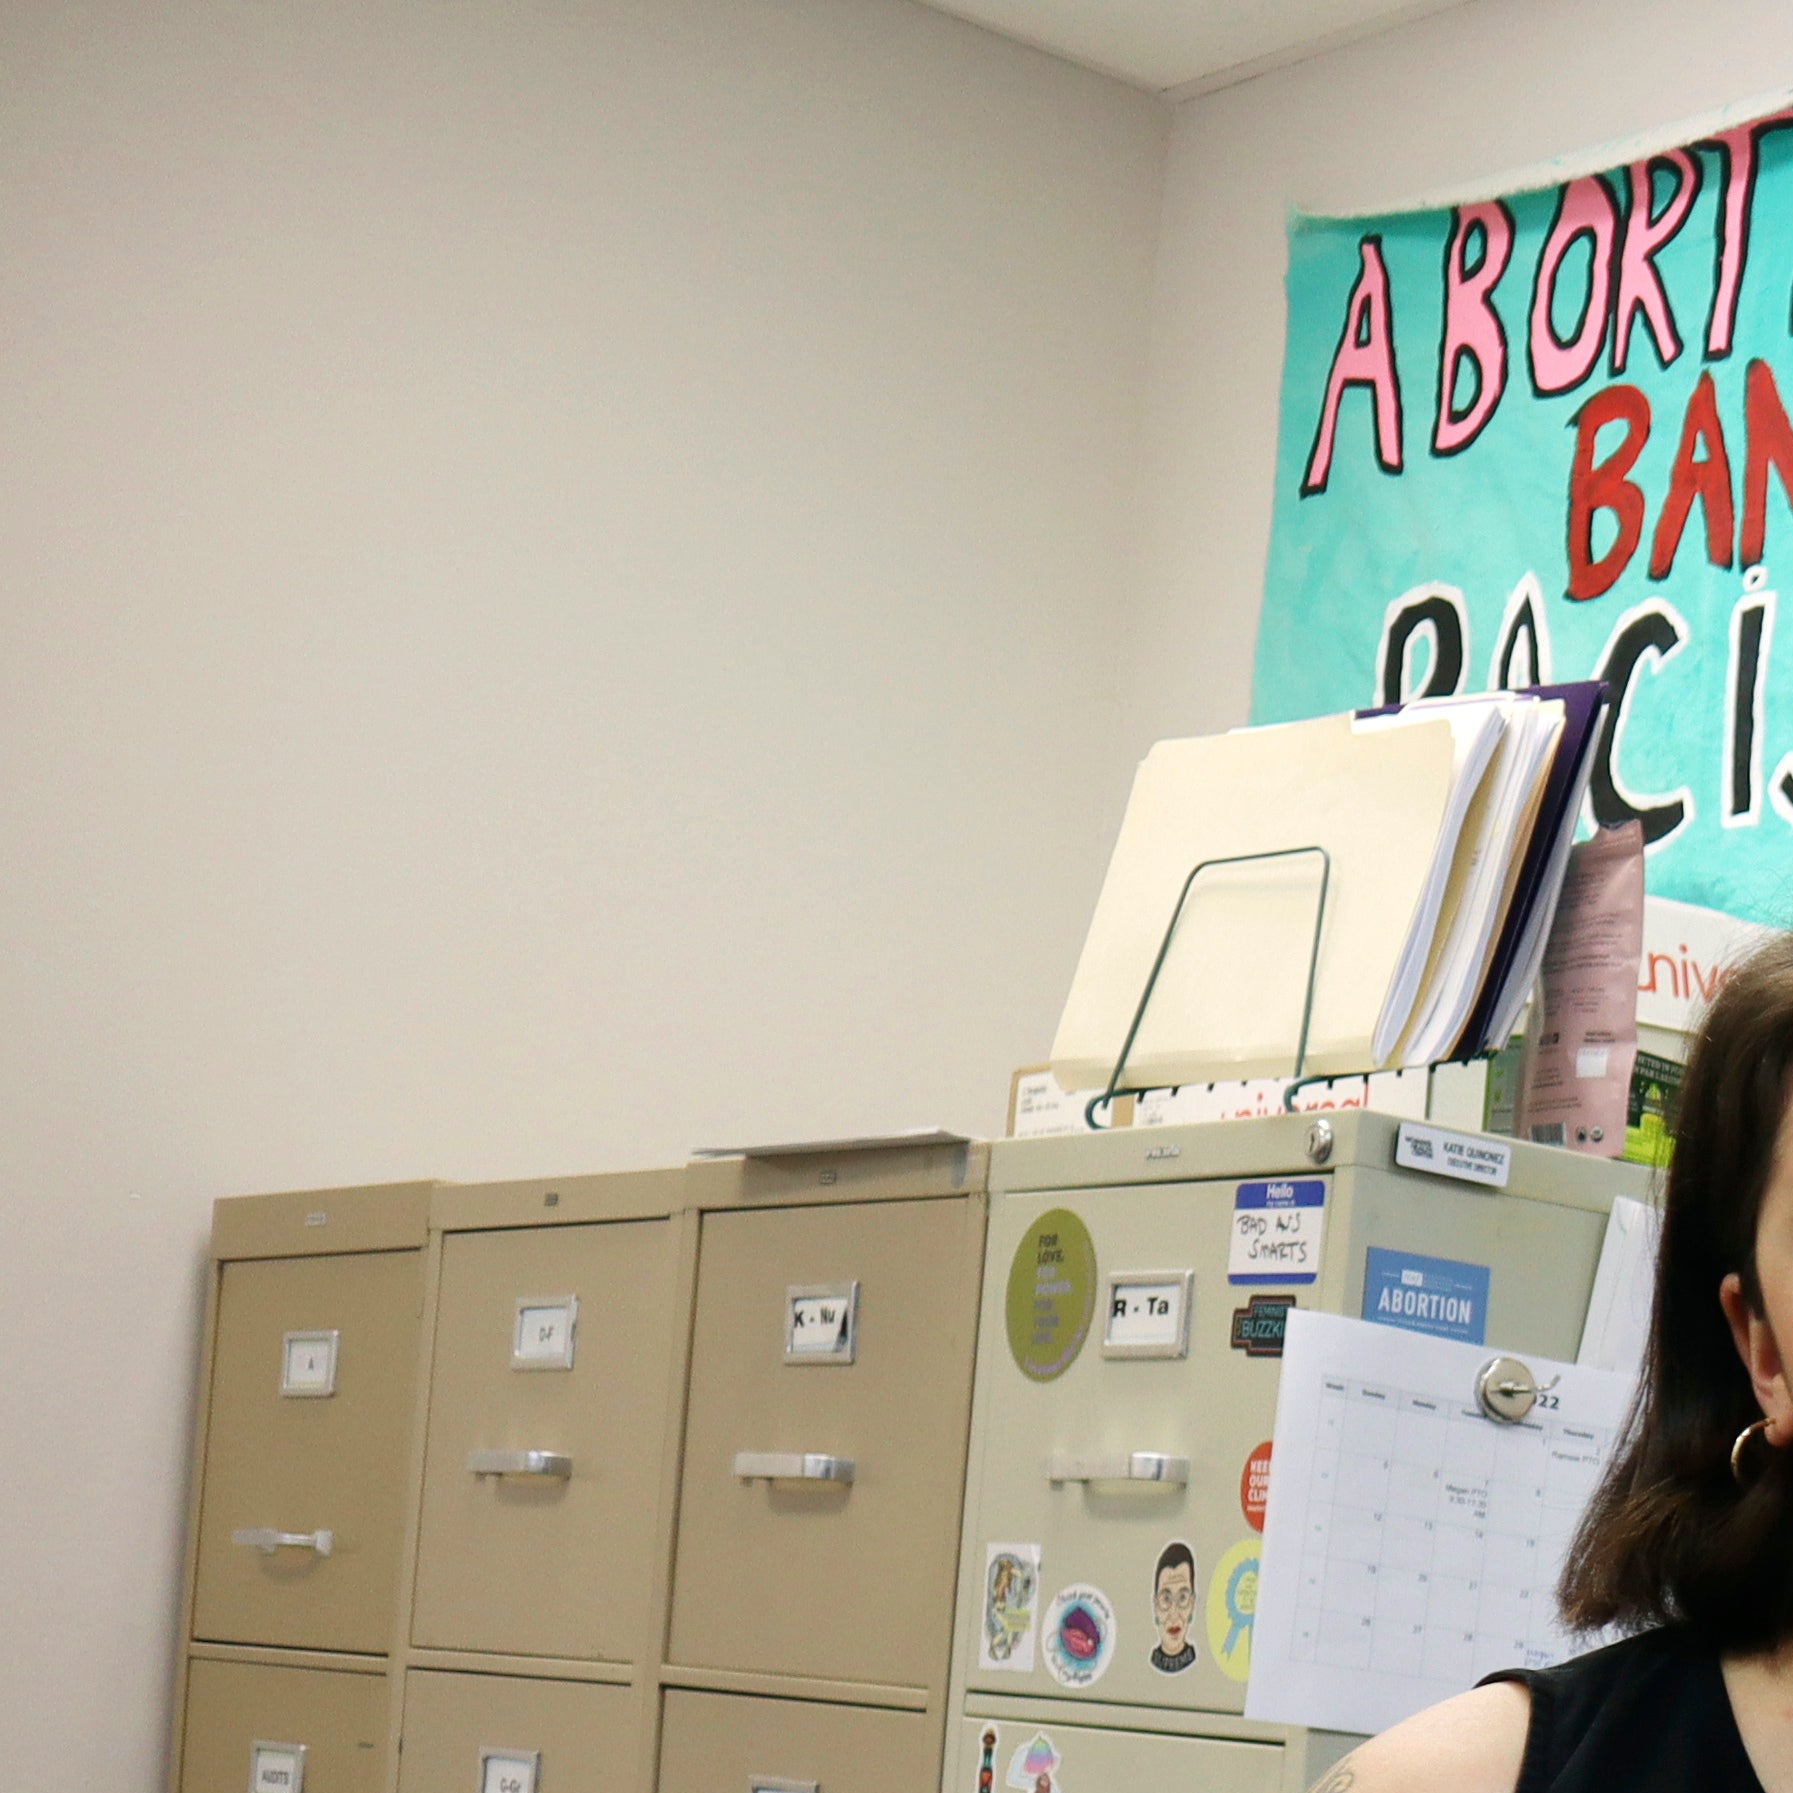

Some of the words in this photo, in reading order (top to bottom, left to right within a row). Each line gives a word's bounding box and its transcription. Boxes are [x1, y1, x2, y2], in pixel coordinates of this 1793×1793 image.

[1266, 1183, 1295, 1199] Hello
[1112, 1299, 1127, 1318] R
[1147, 1297, 1169, 1316] Ta
[1378, 1286, 1474, 1325] ABORTION
[794, 1310, 805, 1329] K
[1241, 1320, 1284, 1339] BUZZKI
